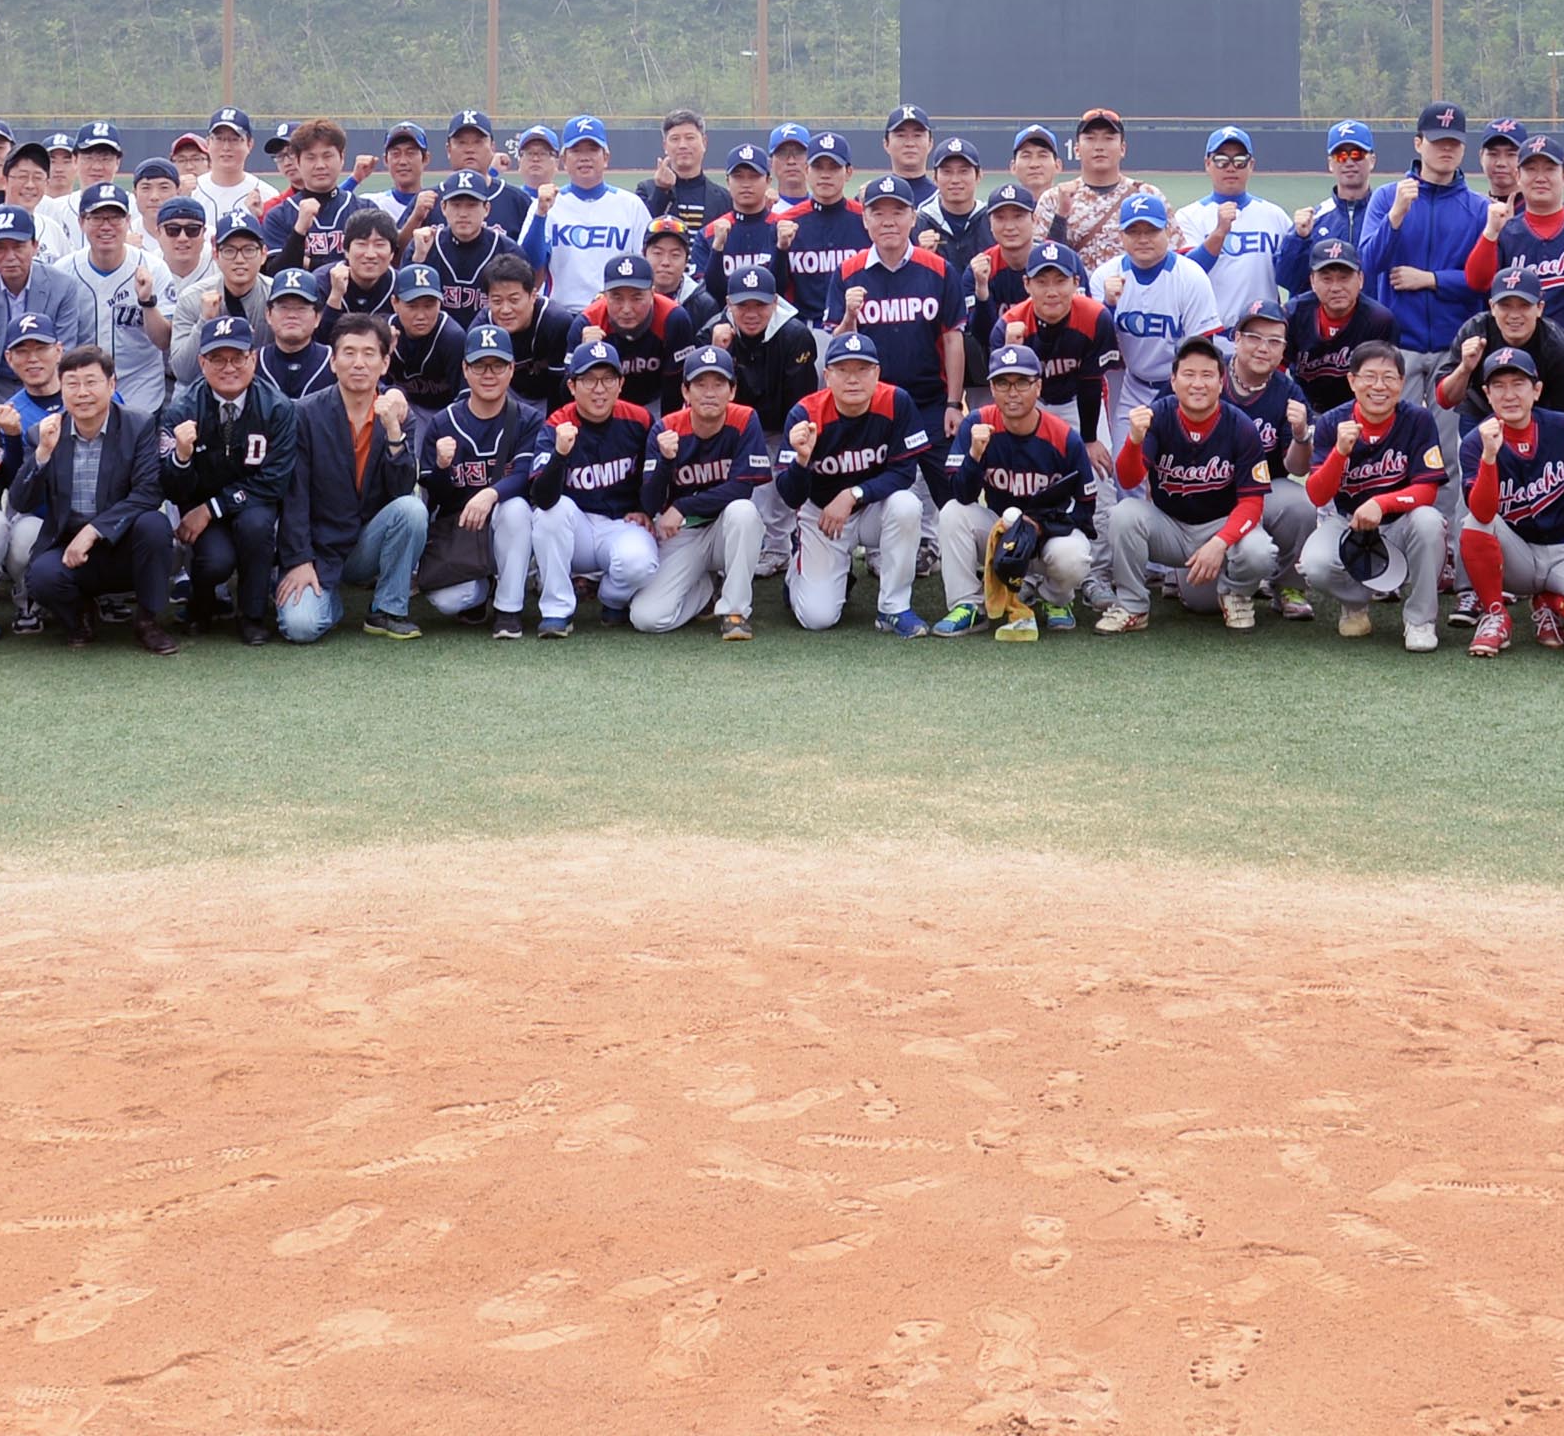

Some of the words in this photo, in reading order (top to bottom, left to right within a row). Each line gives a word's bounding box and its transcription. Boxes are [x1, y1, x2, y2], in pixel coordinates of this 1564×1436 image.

[463, 110, 477, 124] K
[903, 107, 915, 119] K
[458, 173, 473, 188] K
[231, 214, 246, 227] K
[552, 224, 630, 250] KOEN
[286, 271, 300, 287] K
[415, 269, 429, 285] K
[214, 319, 234, 336] M
[481, 330, 497, 347] K
[244, 433, 267, 465] D
[567, 457, 638, 490] KOMIP
